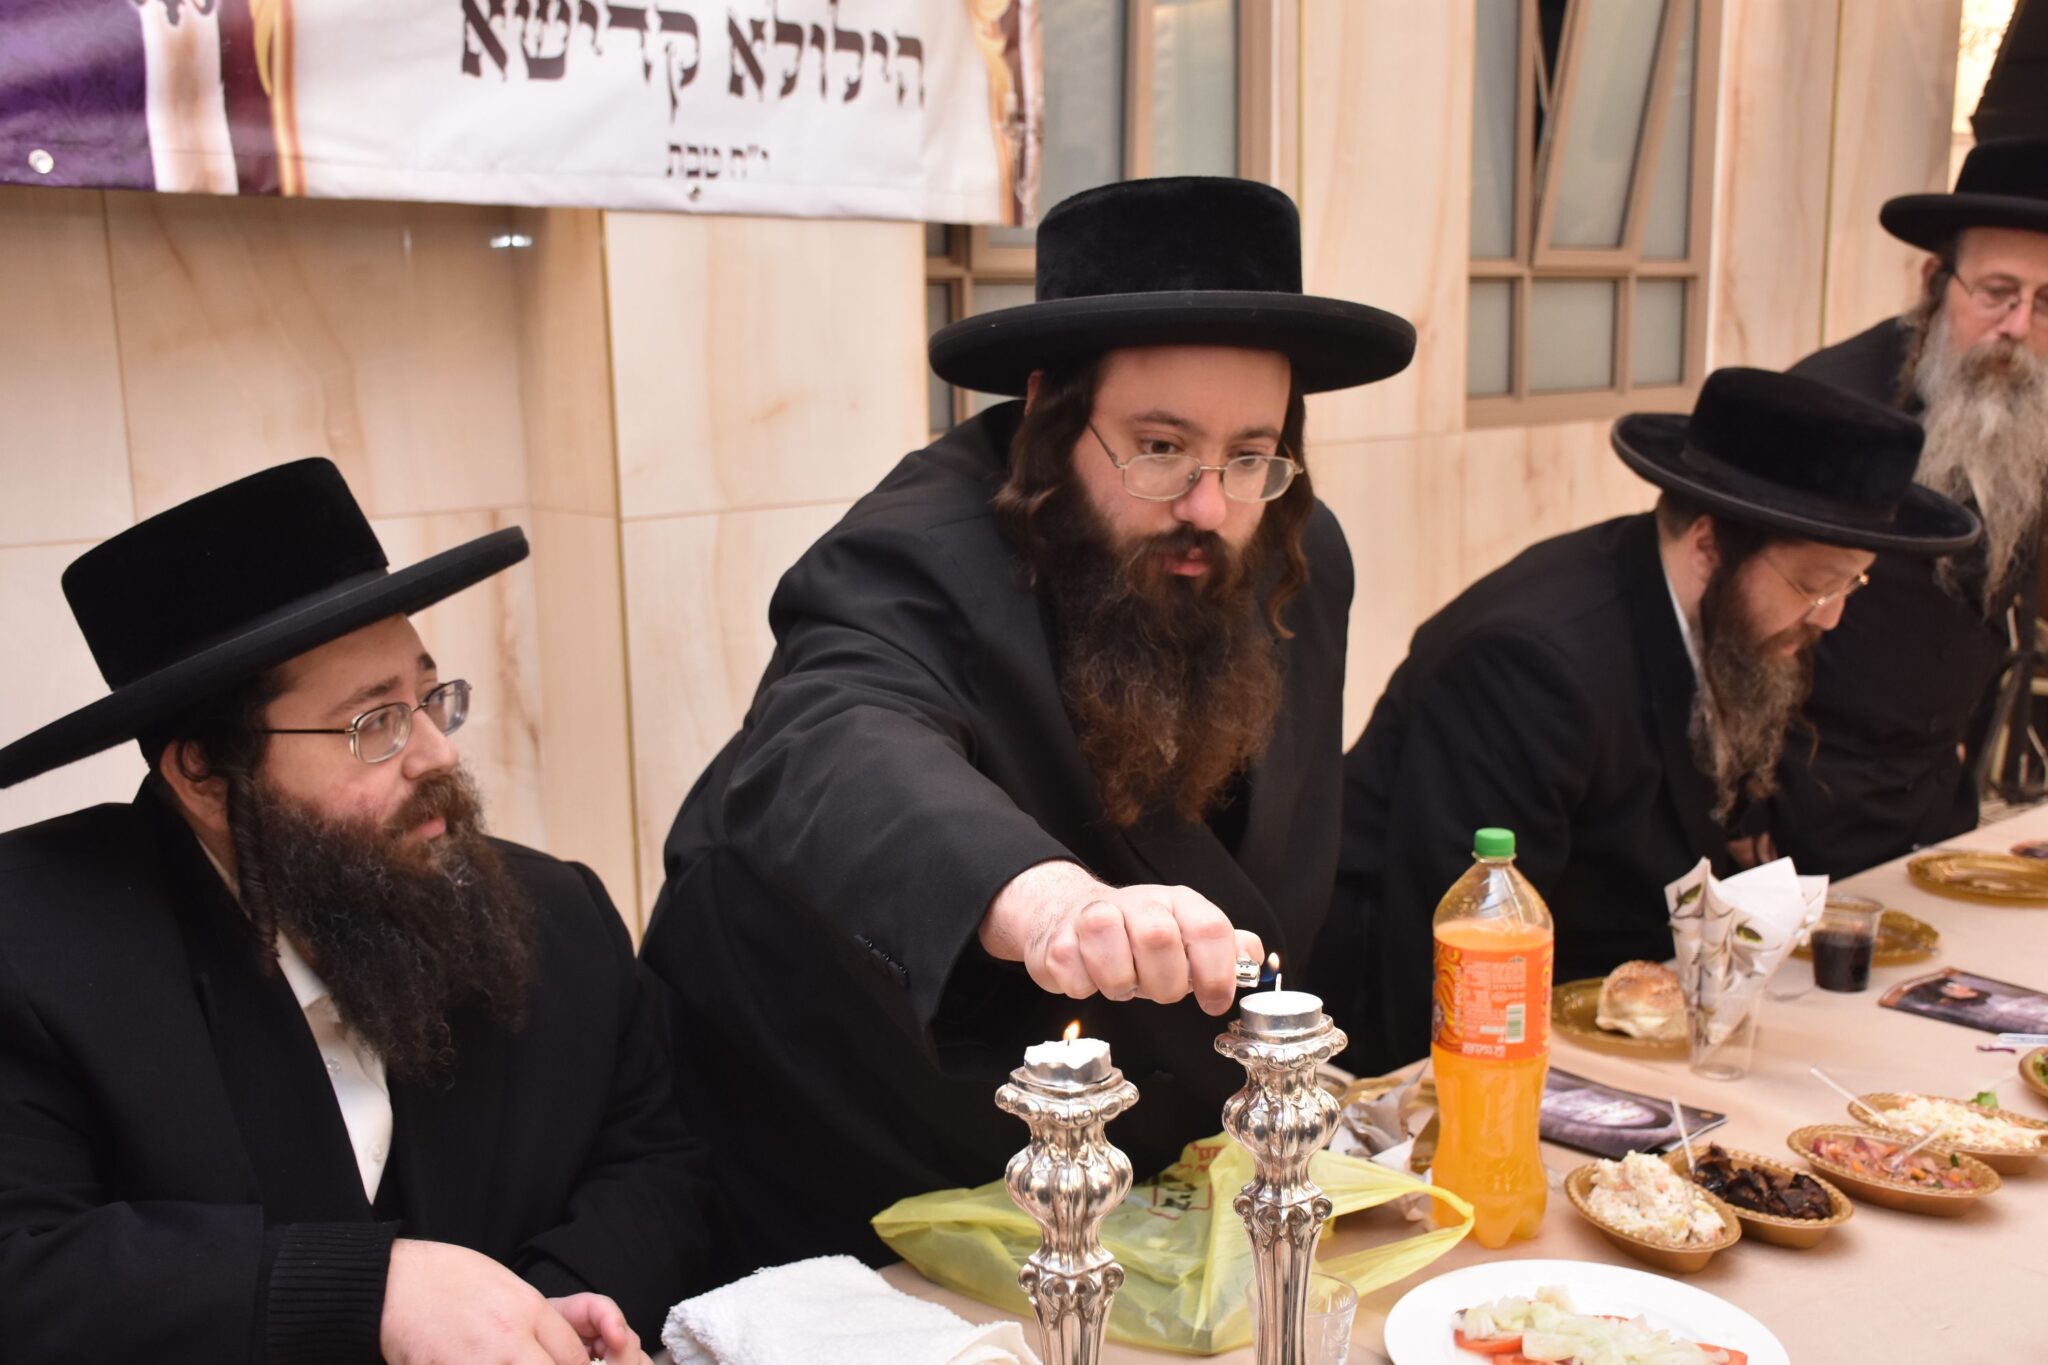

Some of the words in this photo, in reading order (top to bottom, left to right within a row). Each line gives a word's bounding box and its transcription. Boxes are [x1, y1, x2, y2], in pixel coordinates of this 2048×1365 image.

[460, 0, 699, 123] קדישא
[727, 0, 924, 107] הילולא
[666, 143, 720, 179] טבת
